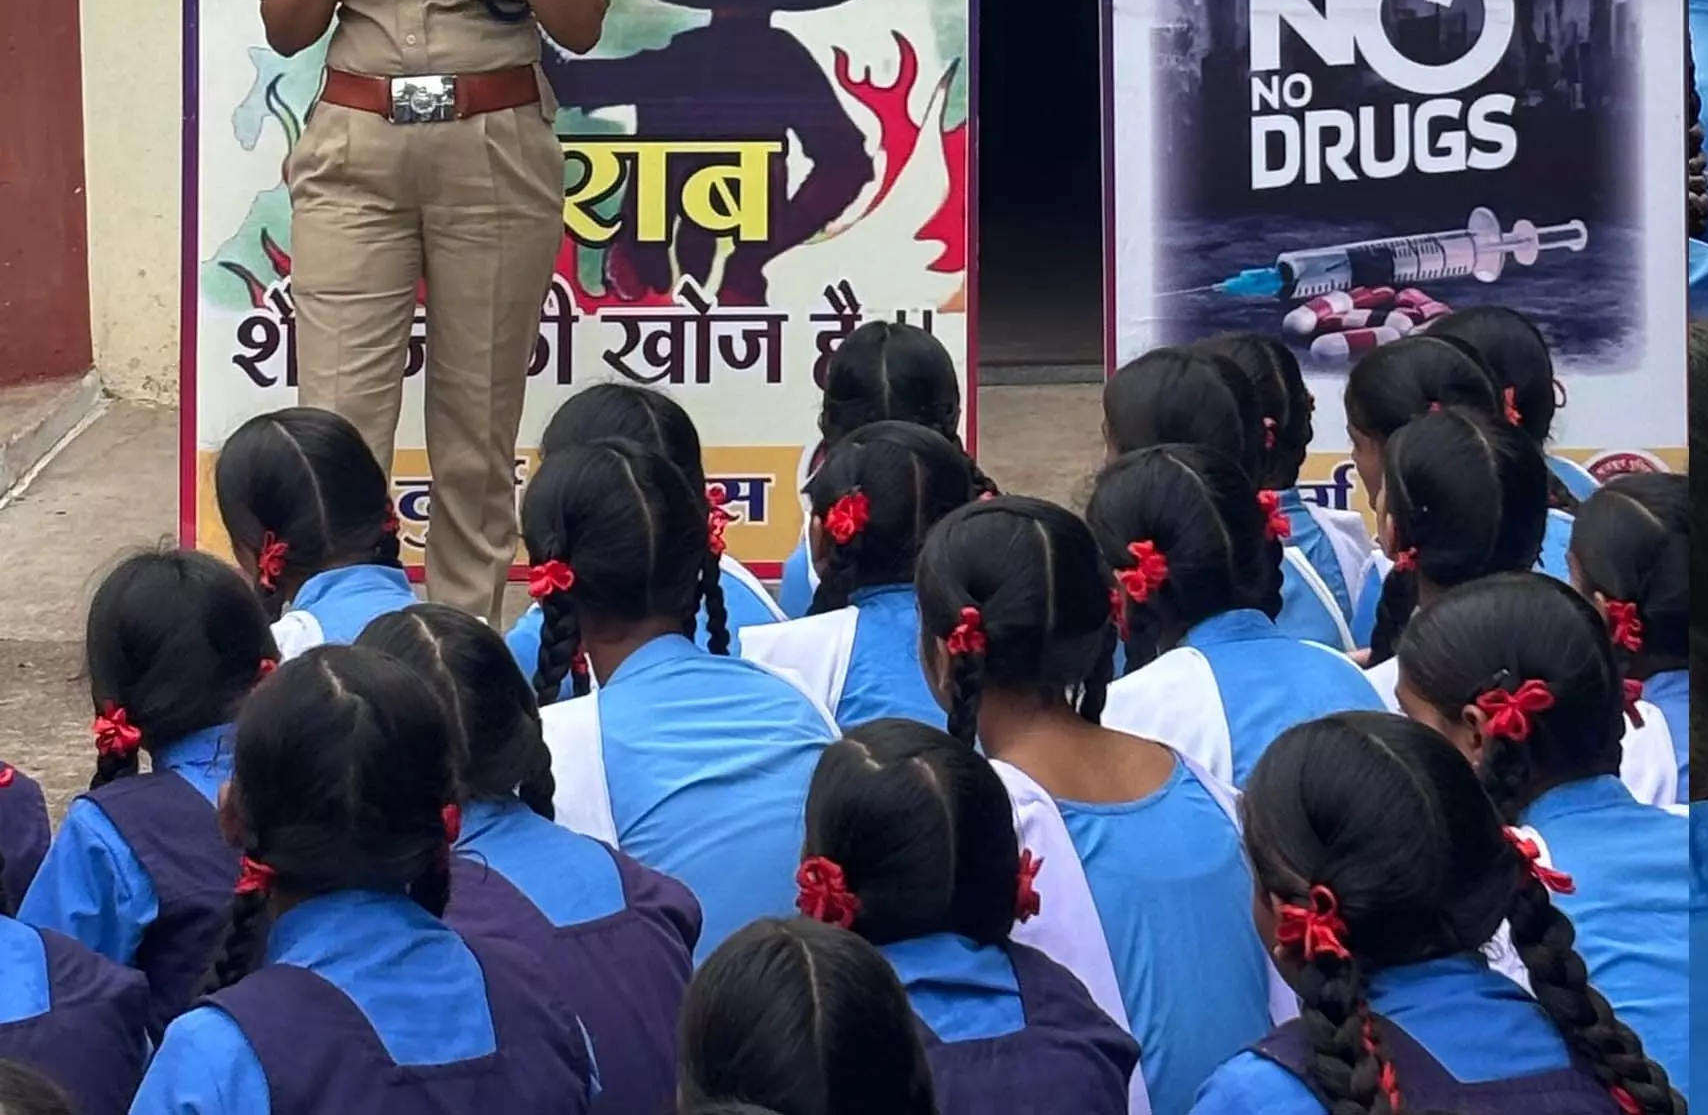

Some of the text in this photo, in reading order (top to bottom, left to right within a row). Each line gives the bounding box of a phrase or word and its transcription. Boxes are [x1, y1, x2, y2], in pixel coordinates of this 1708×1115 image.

[1251, 71, 1313, 112] NO
[561, 136, 783, 248] राब
[1250, 94, 1518, 190] DRUGS
[600, 280, 789, 384] खोज
